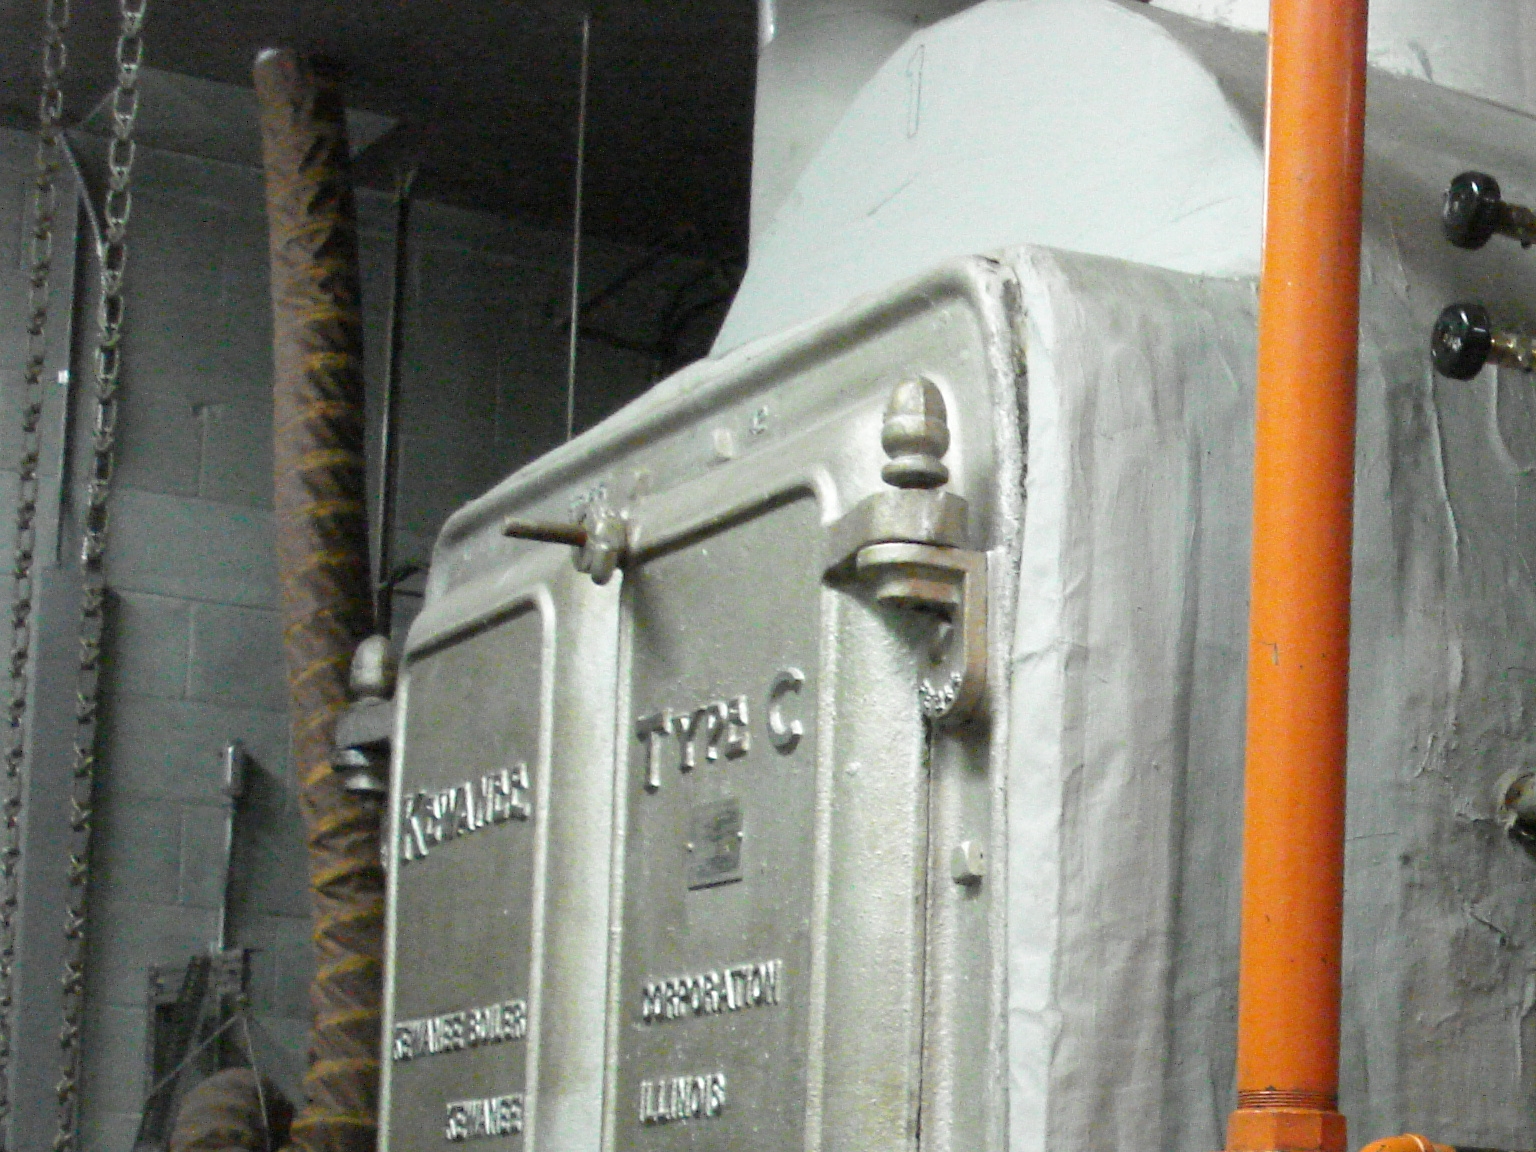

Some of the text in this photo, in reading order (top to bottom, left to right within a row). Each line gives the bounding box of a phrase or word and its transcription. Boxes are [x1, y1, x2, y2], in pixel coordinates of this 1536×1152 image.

[635, 694, 750, 795] TYPE
[401, 762, 532, 864] KEWANEE
[642, 958, 783, 1024] CORPORATION
[639, 1072, 727, 1126] ILLINOIS
